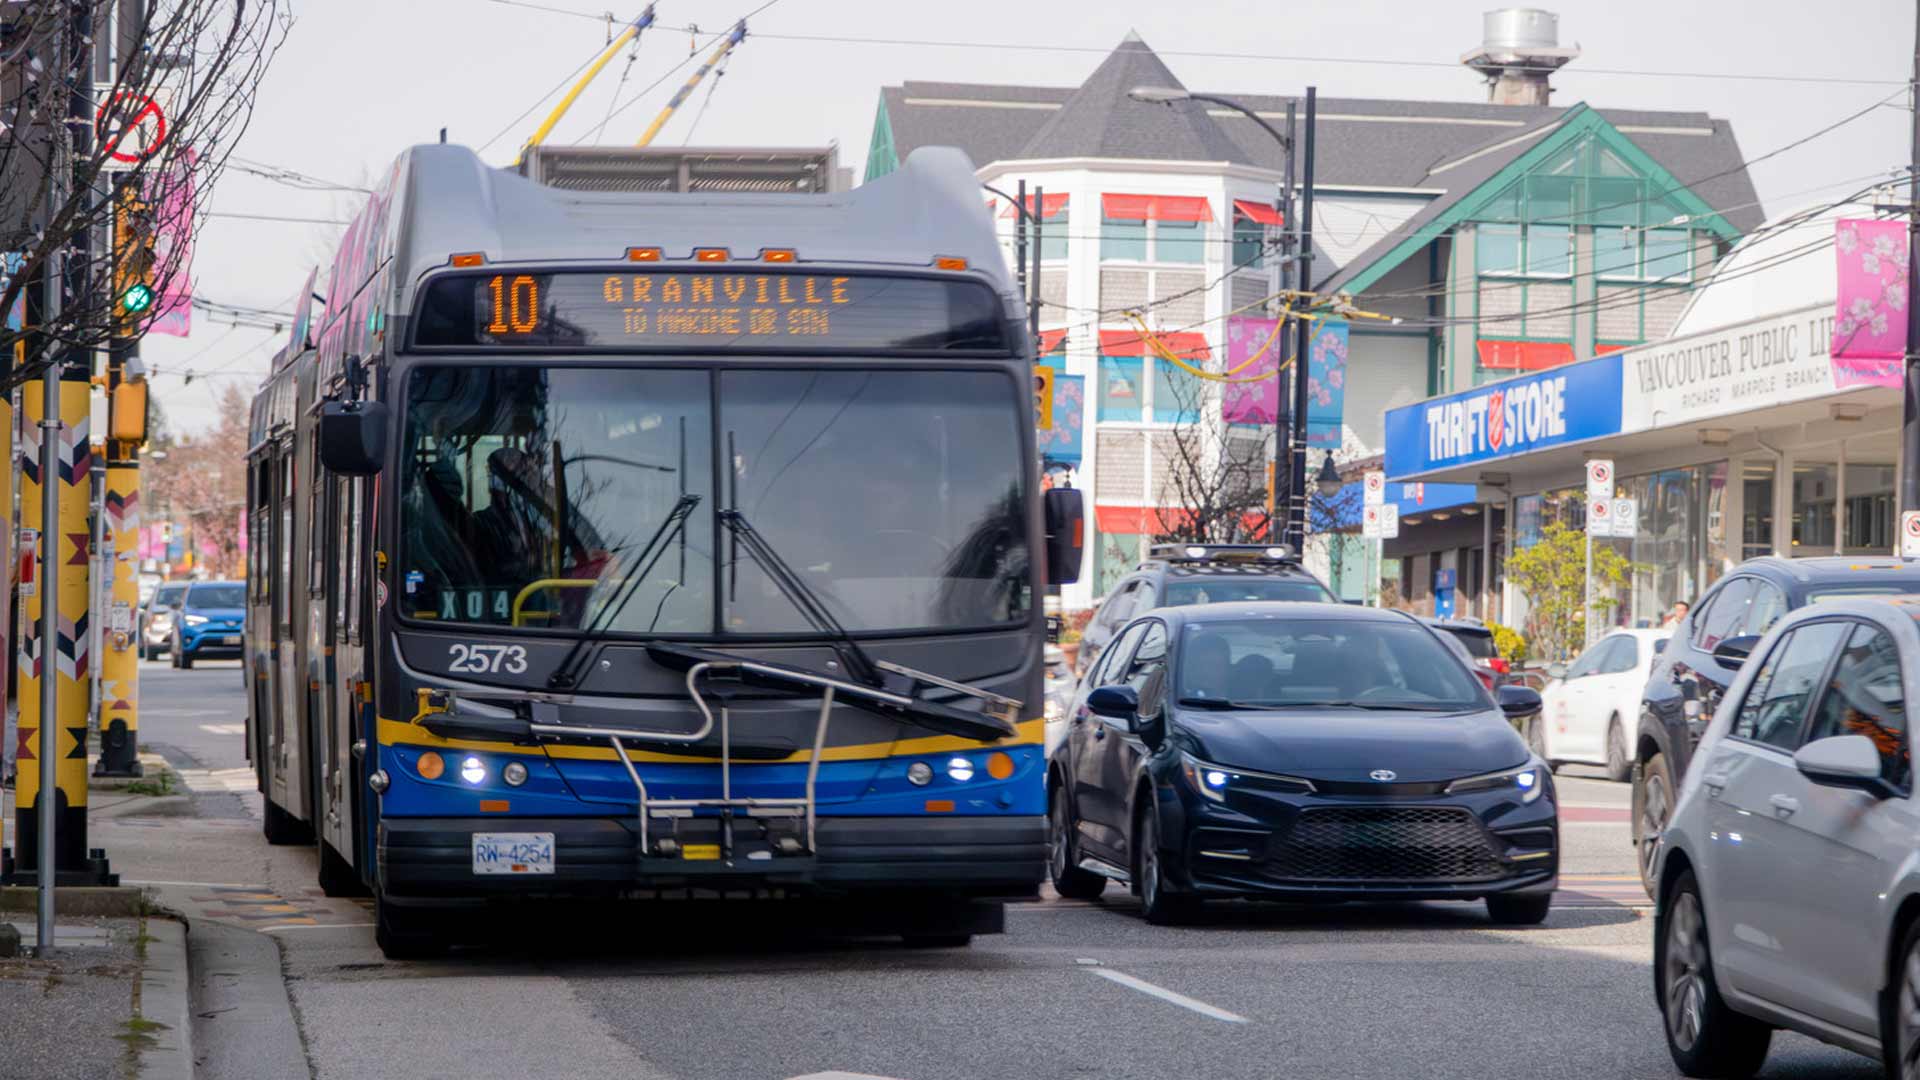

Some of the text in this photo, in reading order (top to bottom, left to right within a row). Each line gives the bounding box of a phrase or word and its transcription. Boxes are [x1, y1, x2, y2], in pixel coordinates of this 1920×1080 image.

[488, 275, 538, 333] 10
[603, 276, 850, 303] GRANVILLE
[623, 308, 831, 335] TO MARINE DR STN
[1636, 339, 1732, 394] VANCOUVER
[1740, 324, 1798, 373] PUBLIC
[1682, 386, 1721, 408] RICHARD
[1732, 375, 1776, 399] MARPOLE
[1786, 365, 1829, 389] BRANCH
[1427, 376, 1567, 461] THRIFT STORE
[448, 643, 528, 674] 2573
